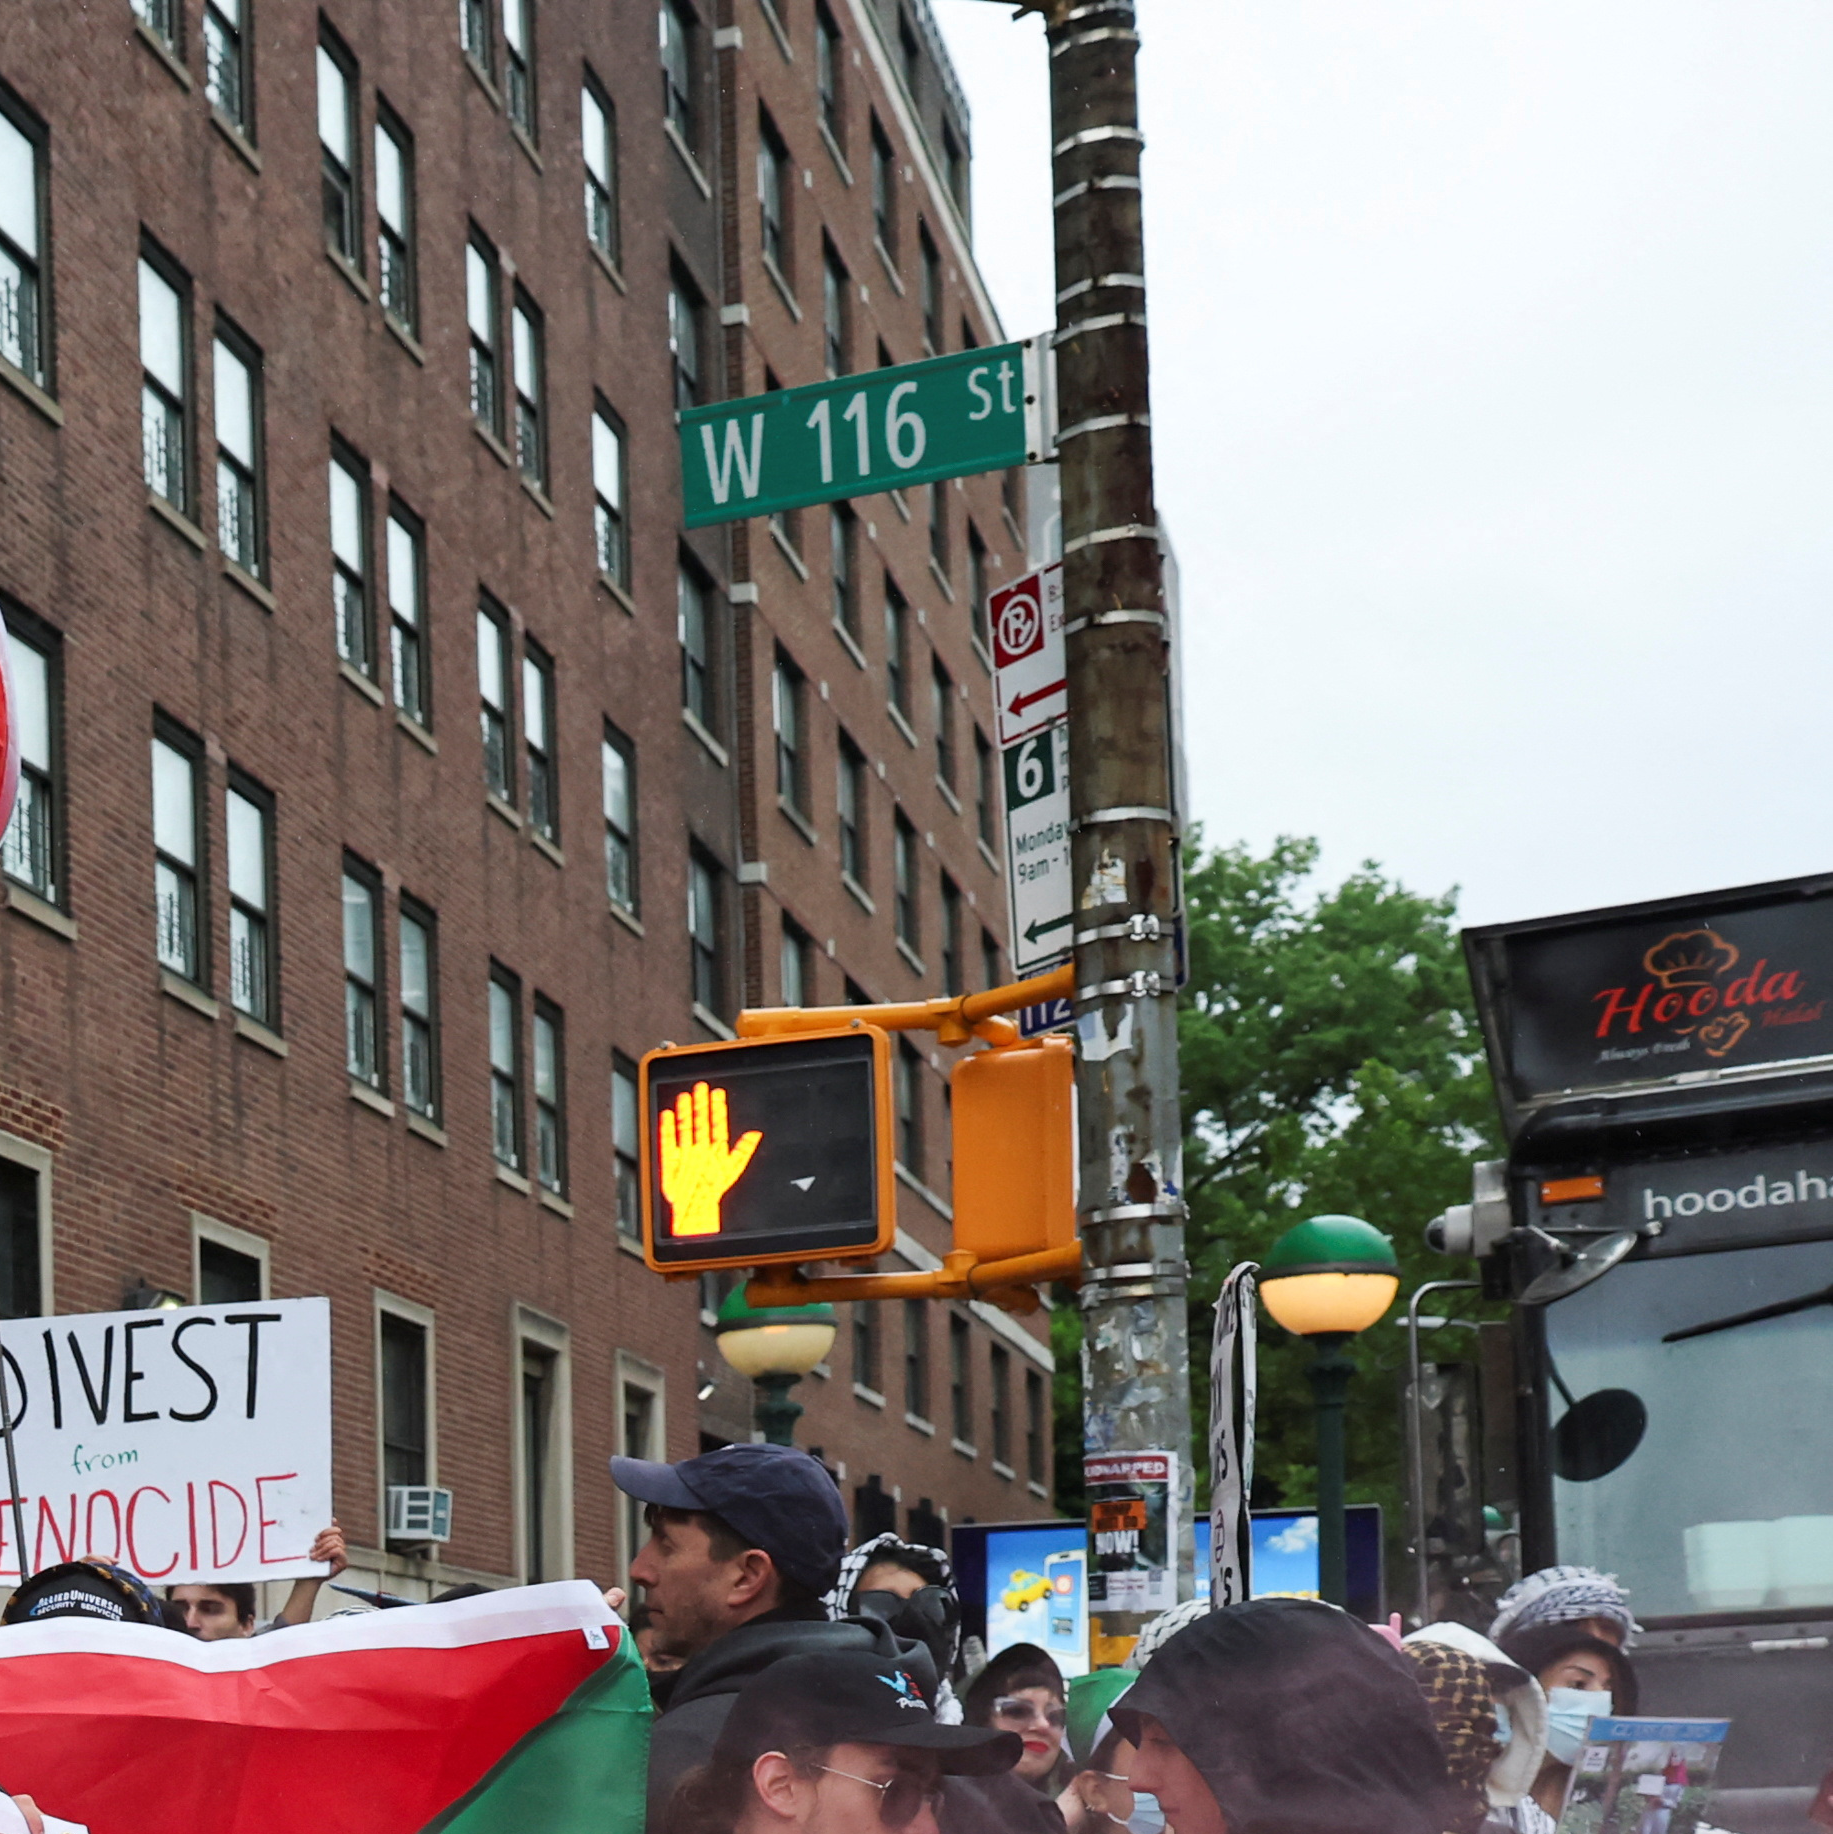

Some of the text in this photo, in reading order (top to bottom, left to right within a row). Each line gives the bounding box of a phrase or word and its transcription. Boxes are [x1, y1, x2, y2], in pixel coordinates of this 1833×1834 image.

[700, 360, 1017, 505] W 116 St
[1016, 737, 1044, 799] 6
[1591, 958, 1808, 1039] Hooda
[72, 1444, 139, 1476] from
[36, 1601, 76, 1616] SECURITY
